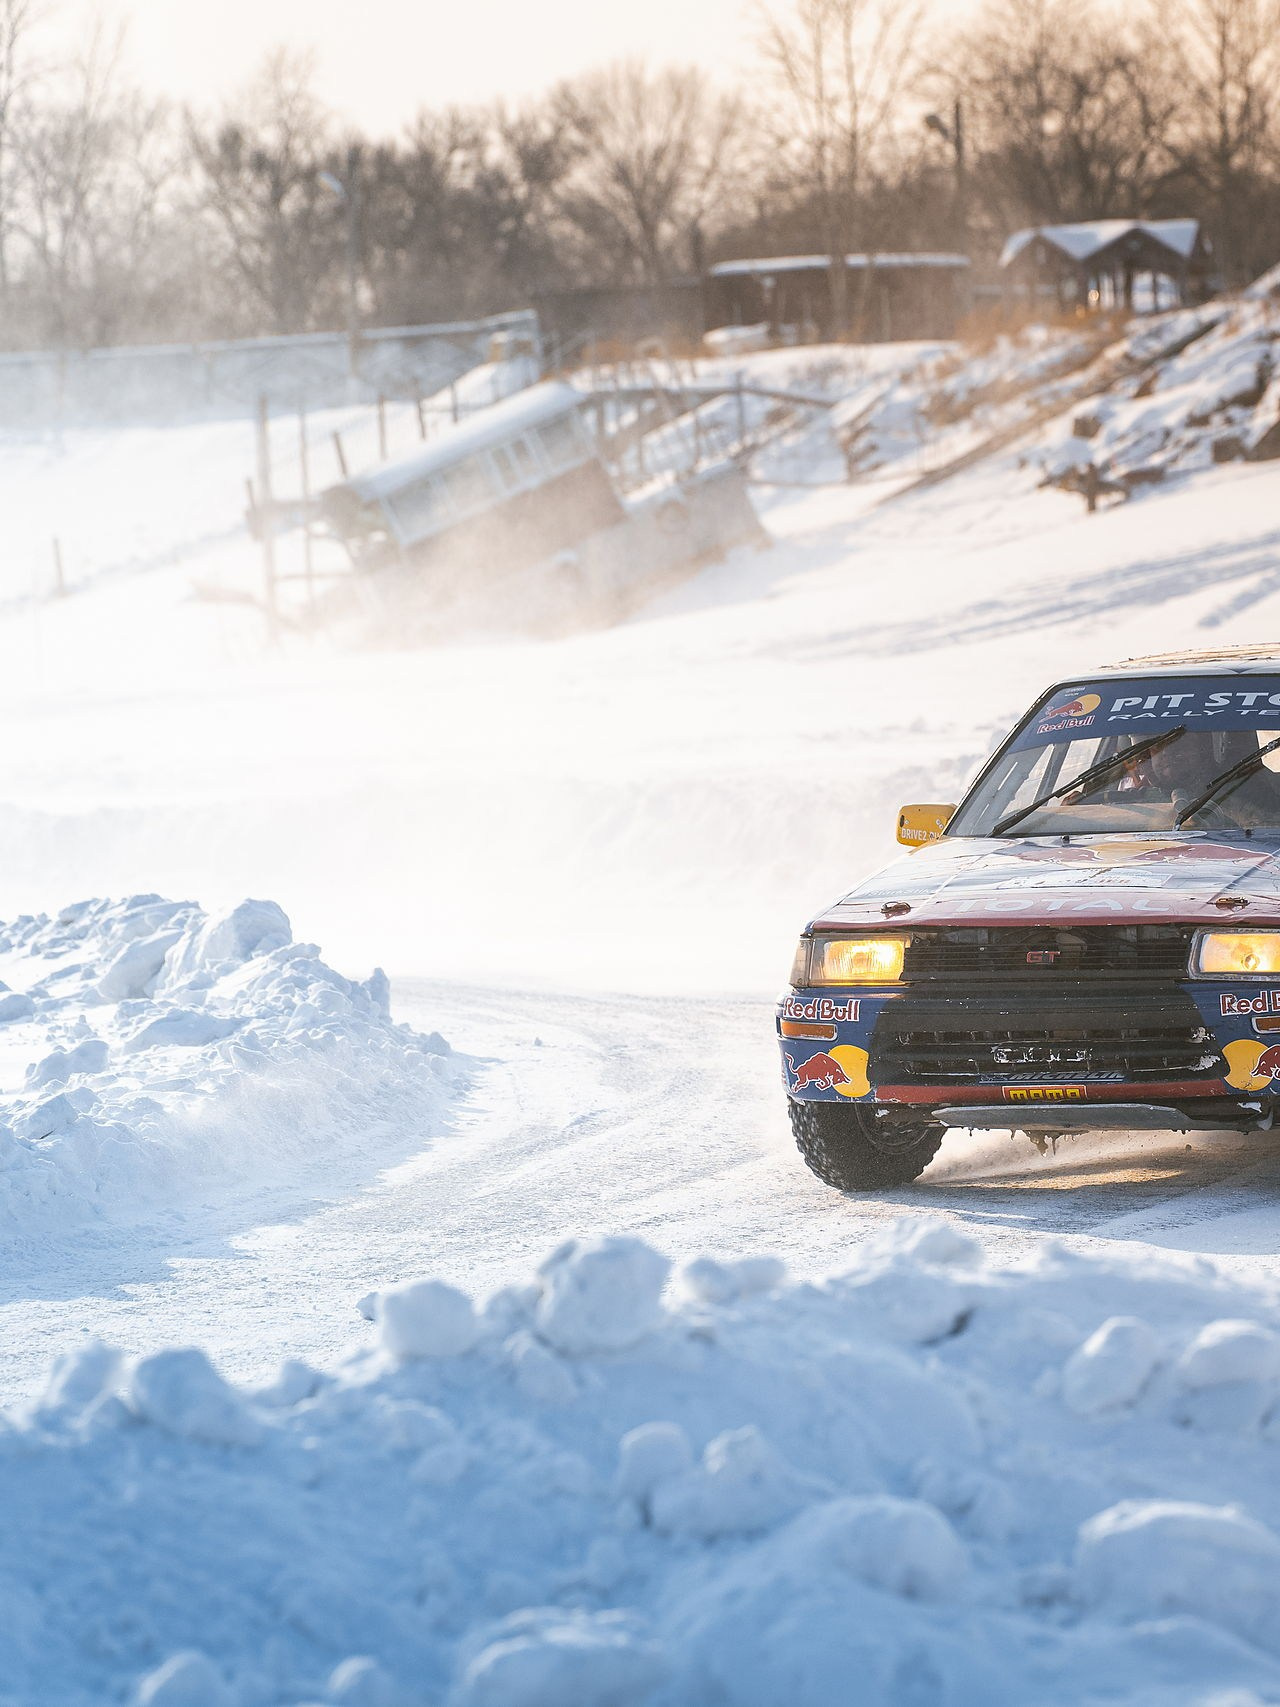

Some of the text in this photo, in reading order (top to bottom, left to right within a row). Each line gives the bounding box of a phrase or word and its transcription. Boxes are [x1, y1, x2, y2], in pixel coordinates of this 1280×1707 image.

[1110, 693, 1195, 713] PIT
[1036, 714, 1095, 734] Red Bull
[1107, 708, 1225, 722] RALLY
[949, 898, 1170, 912] TOTAL
[783, 995, 861, 1022] Red Bull
[1220, 990, 1269, 1016] Red
